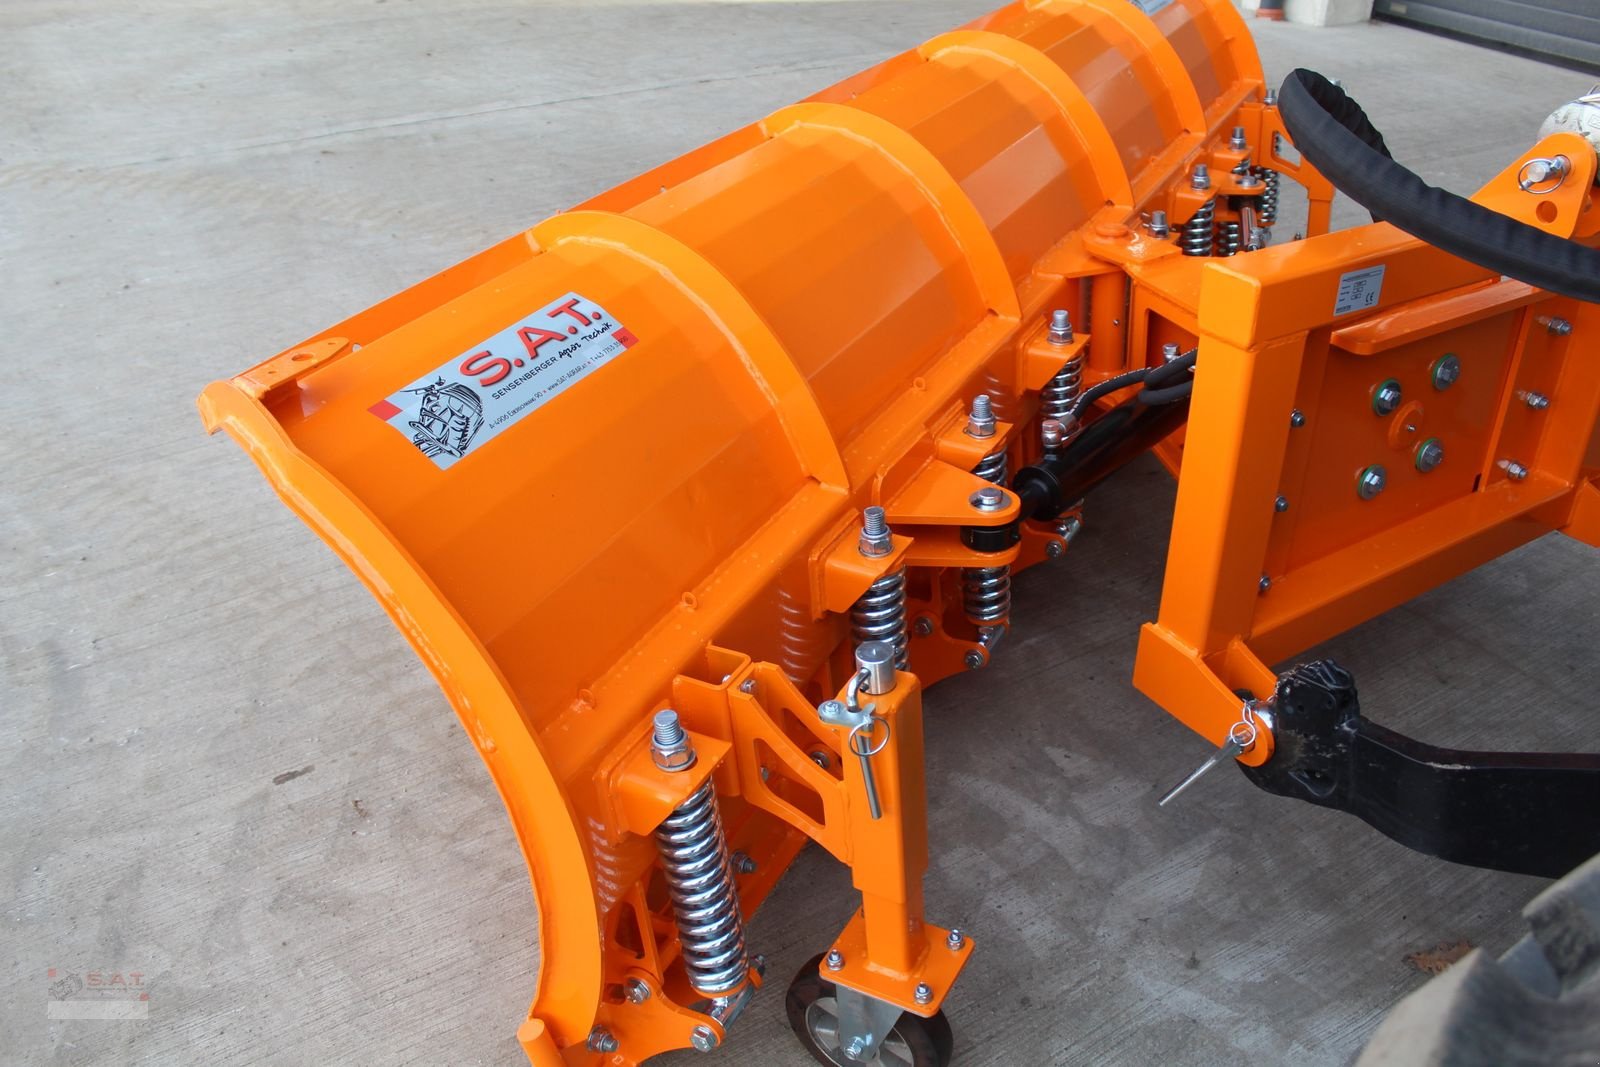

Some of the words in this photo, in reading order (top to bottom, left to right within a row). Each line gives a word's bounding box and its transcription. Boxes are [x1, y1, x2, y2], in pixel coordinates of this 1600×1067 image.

[459, 298, 602, 388] S.A.T.
[491, 356, 558, 400] SENSENBERGER
[558, 342, 582, 359] Agrar
[581, 322, 613, 342] Technik
